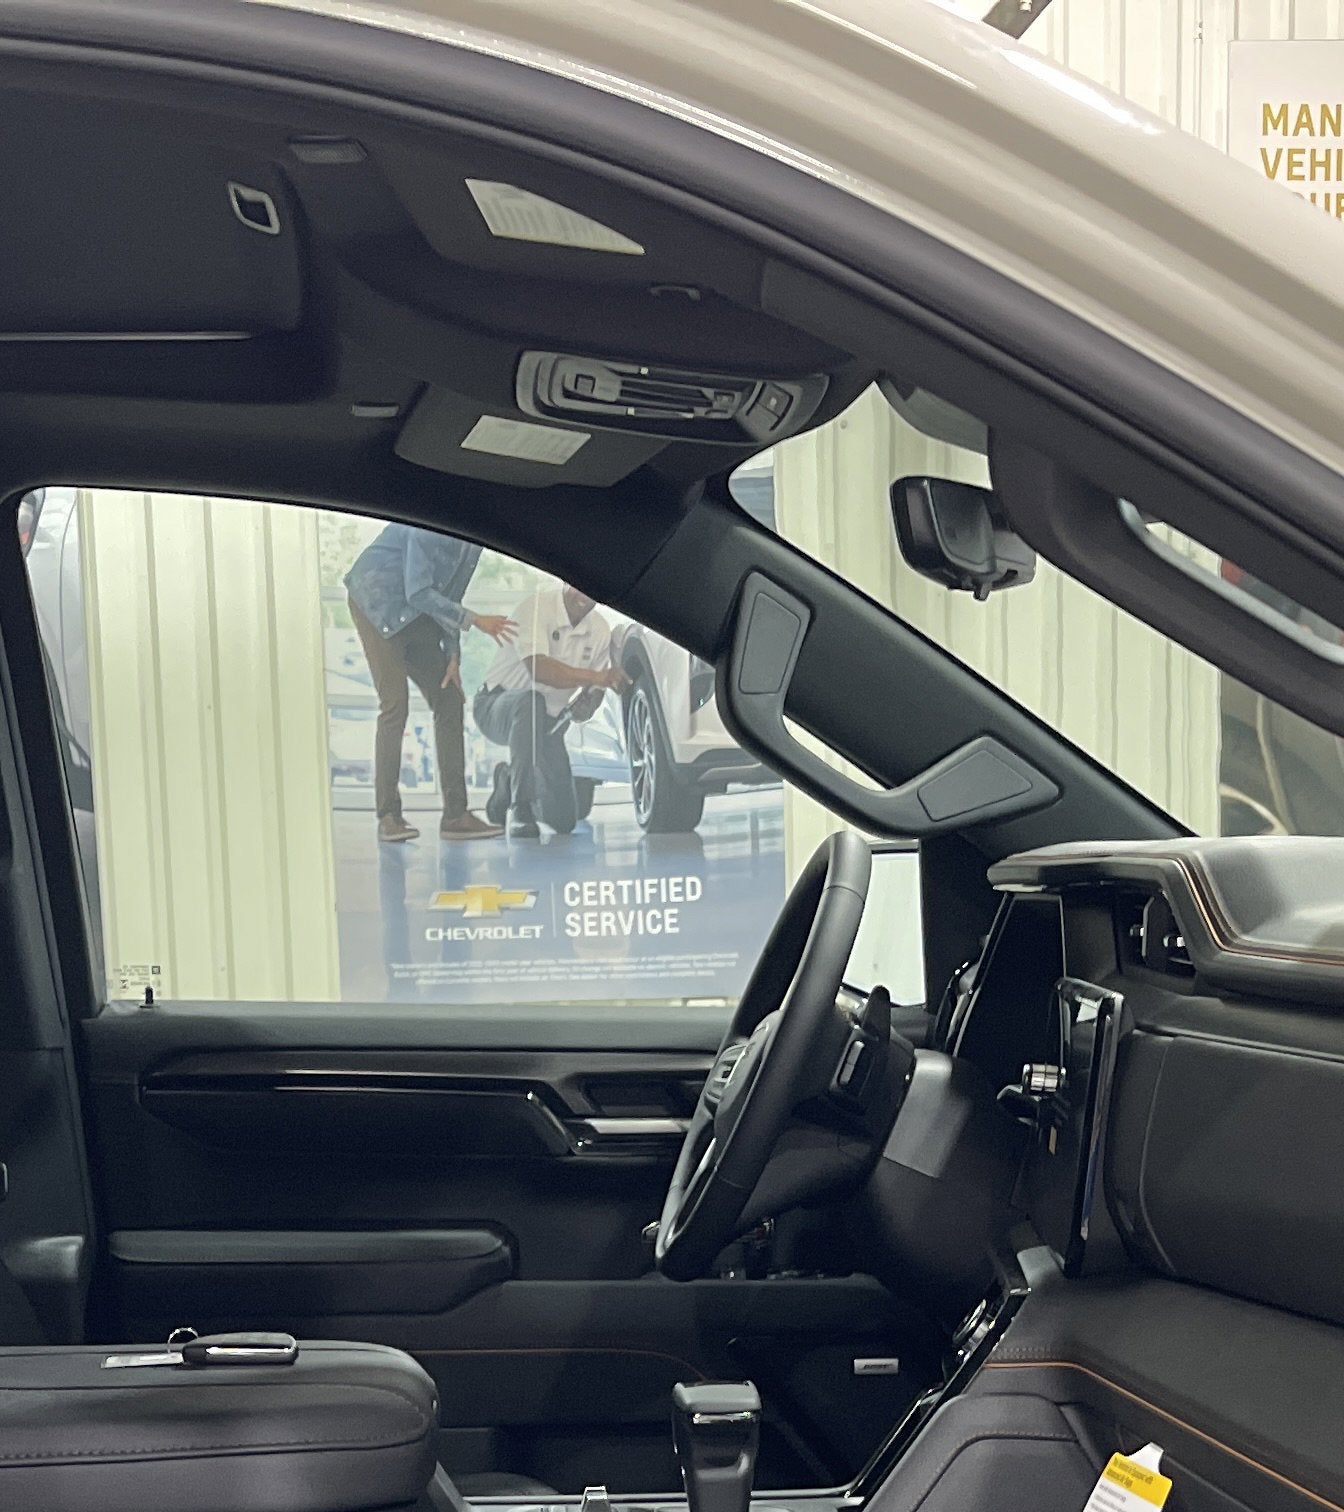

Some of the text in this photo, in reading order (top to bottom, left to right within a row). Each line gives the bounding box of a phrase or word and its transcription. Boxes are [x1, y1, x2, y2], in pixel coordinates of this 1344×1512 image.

[563, 876, 703, 907] CERTIFIED
[425, 924, 544, 941] CHEVROLET
[564, 908, 680, 937] SERVICE
